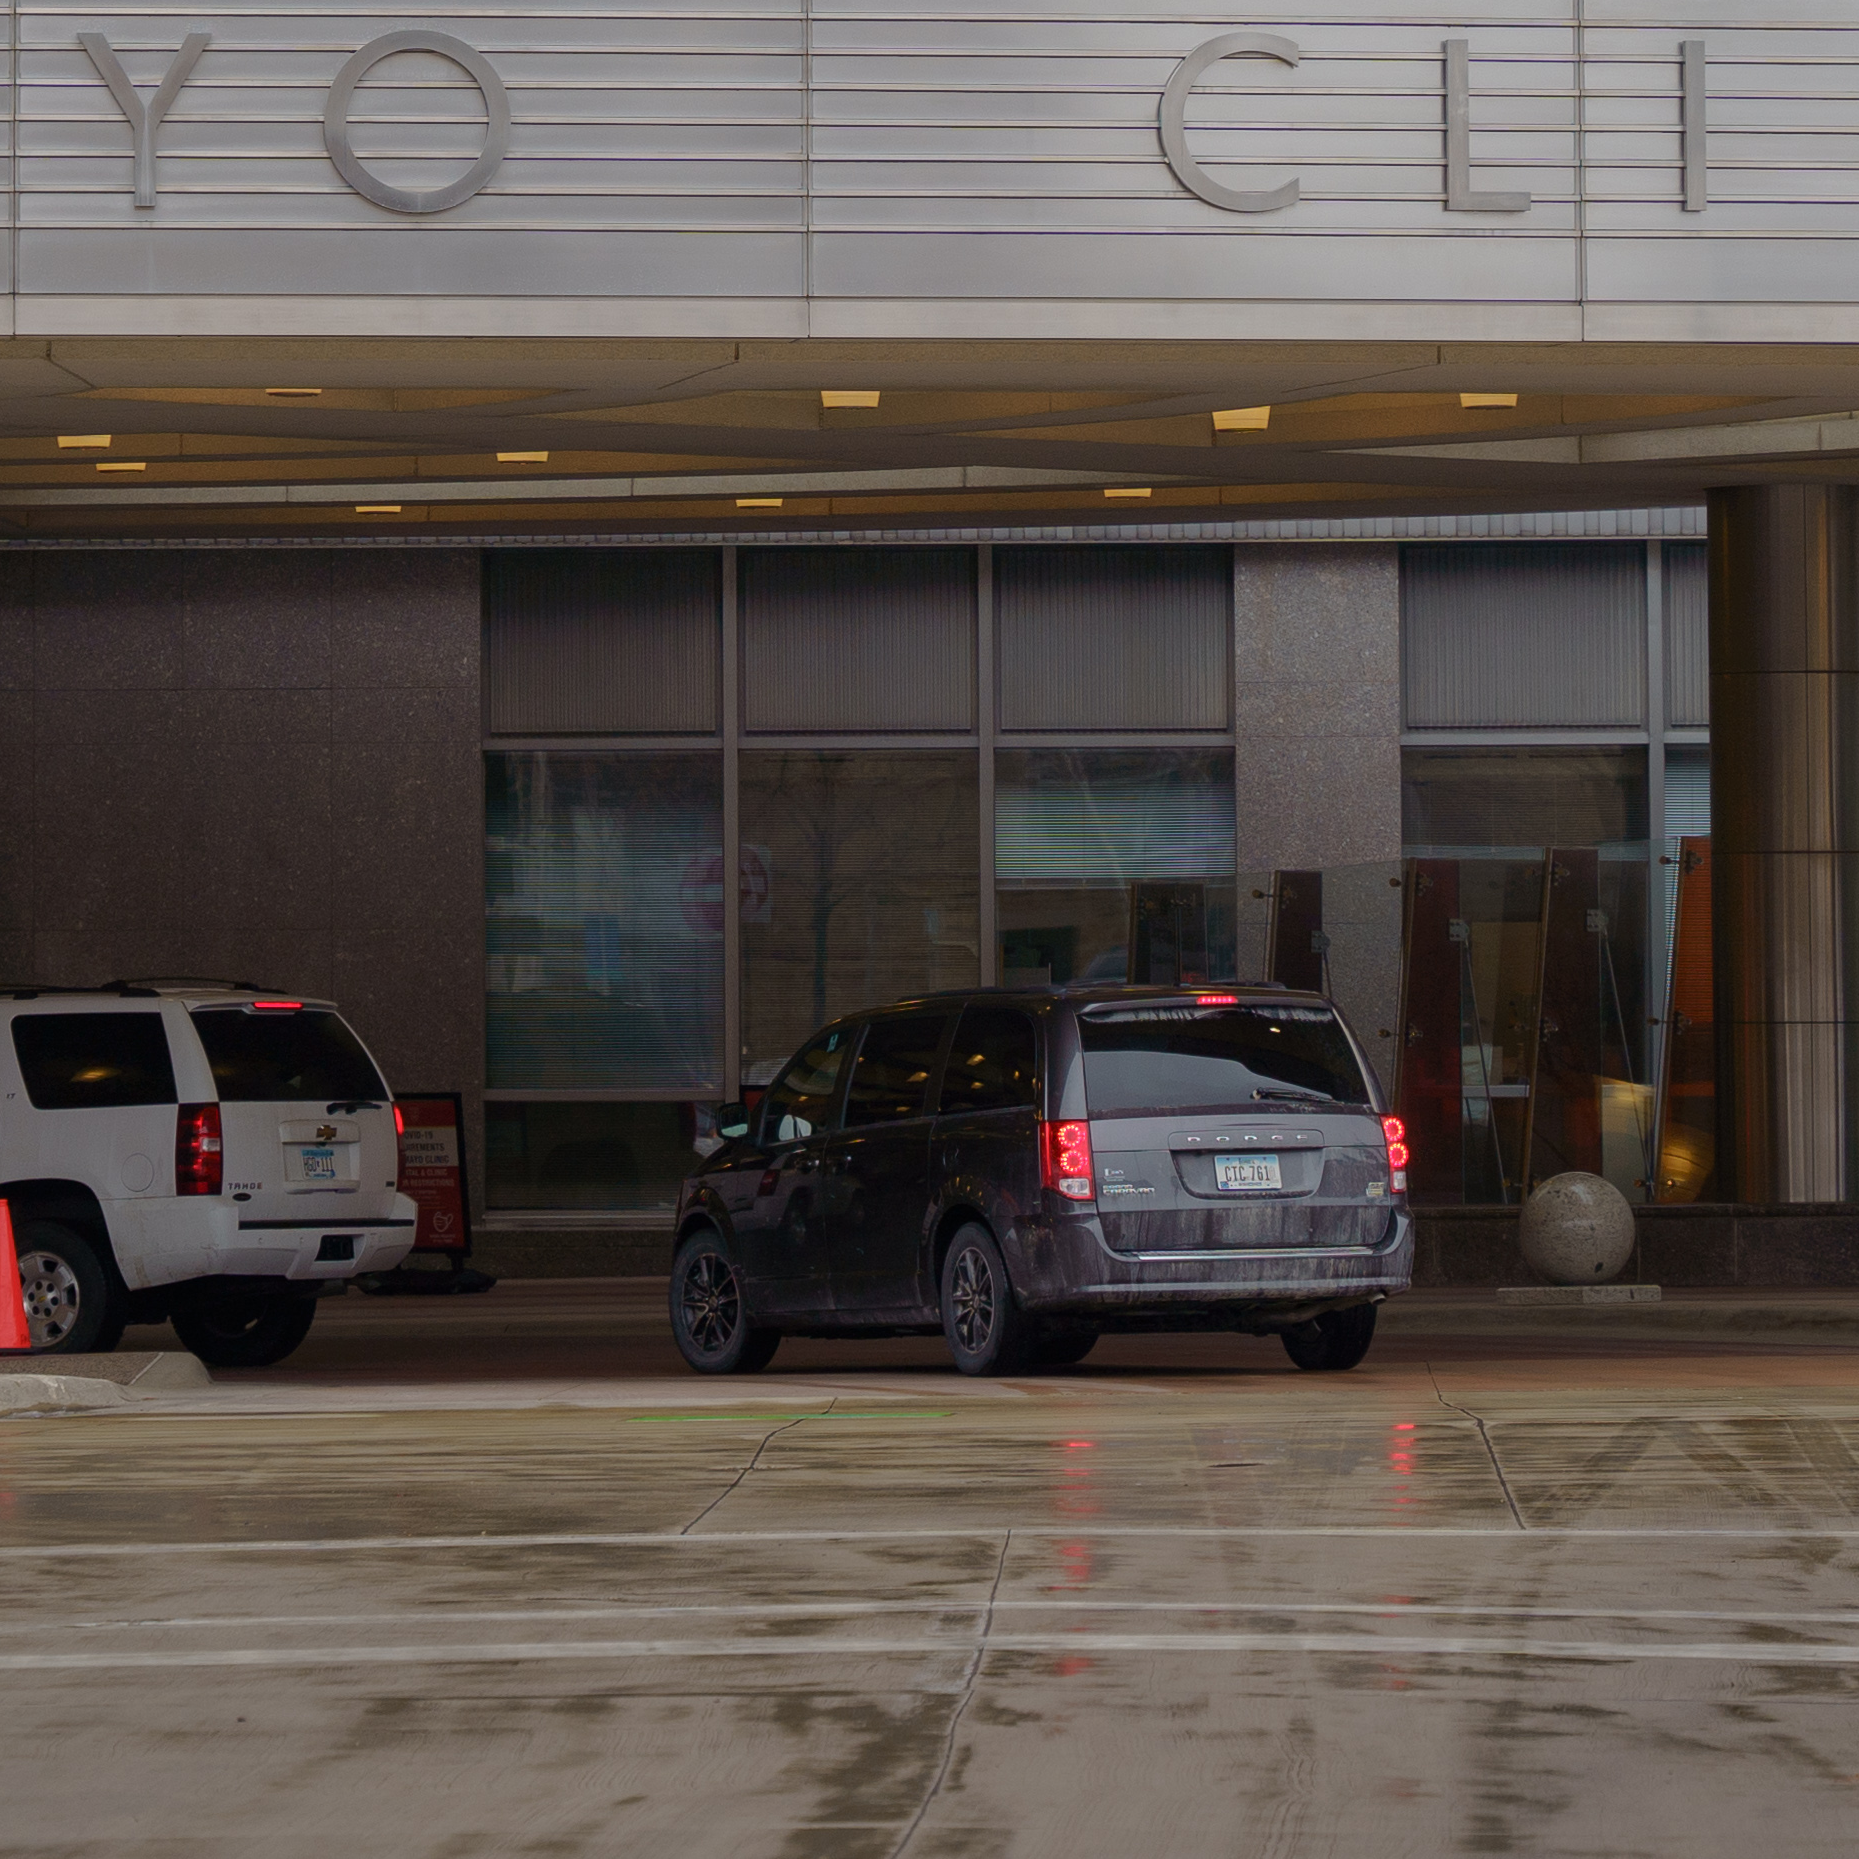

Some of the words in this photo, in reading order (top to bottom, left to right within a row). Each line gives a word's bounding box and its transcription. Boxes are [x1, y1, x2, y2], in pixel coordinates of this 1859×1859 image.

[1187, 1134, 1308, 1142] DODGE
[1224, 1165, 1247, 1182] CTC
[1249, 1164, 1270, 1181] 761
[227, 1182, 263, 1191] TAHOE
